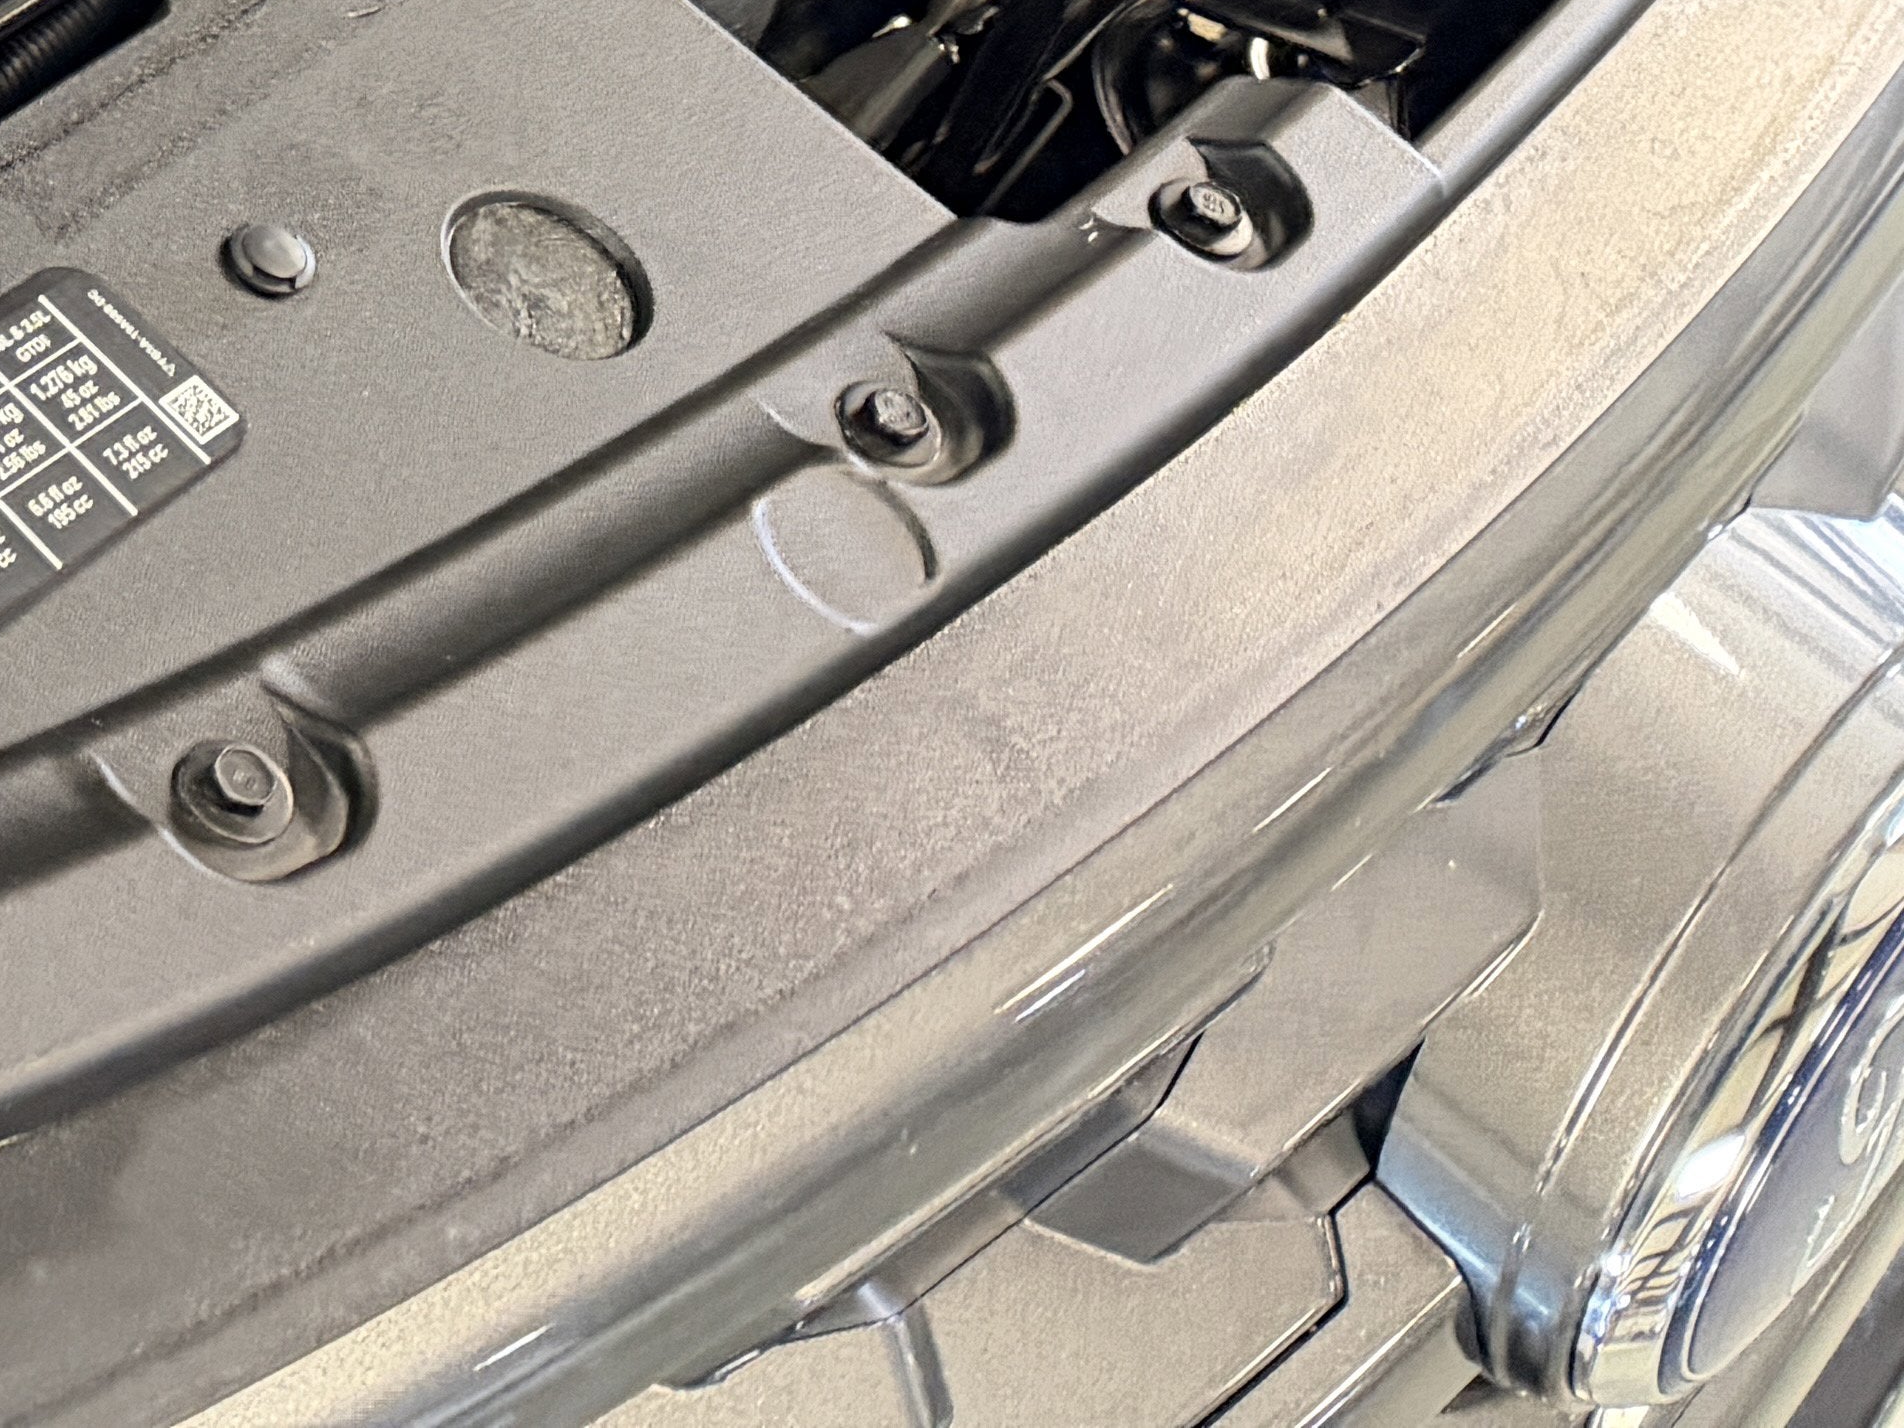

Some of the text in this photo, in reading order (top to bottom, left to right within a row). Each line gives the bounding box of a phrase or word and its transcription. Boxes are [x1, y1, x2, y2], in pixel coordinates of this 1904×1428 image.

[30, 354, 98, 401] 1.276 kg
[61, 380, 100, 408] 45 oz
[93, 391, 121, 413] lbs
[3, 428, 25, 448] oz
[18, 440, 46, 463] lbs
[103, 441, 130, 466] 7.3
[136, 425, 158, 445] oz
[122, 443, 169, 480] 215 cc
[61, 475, 83, 495] oz
[48, 494, 94, 529] 195 cc
